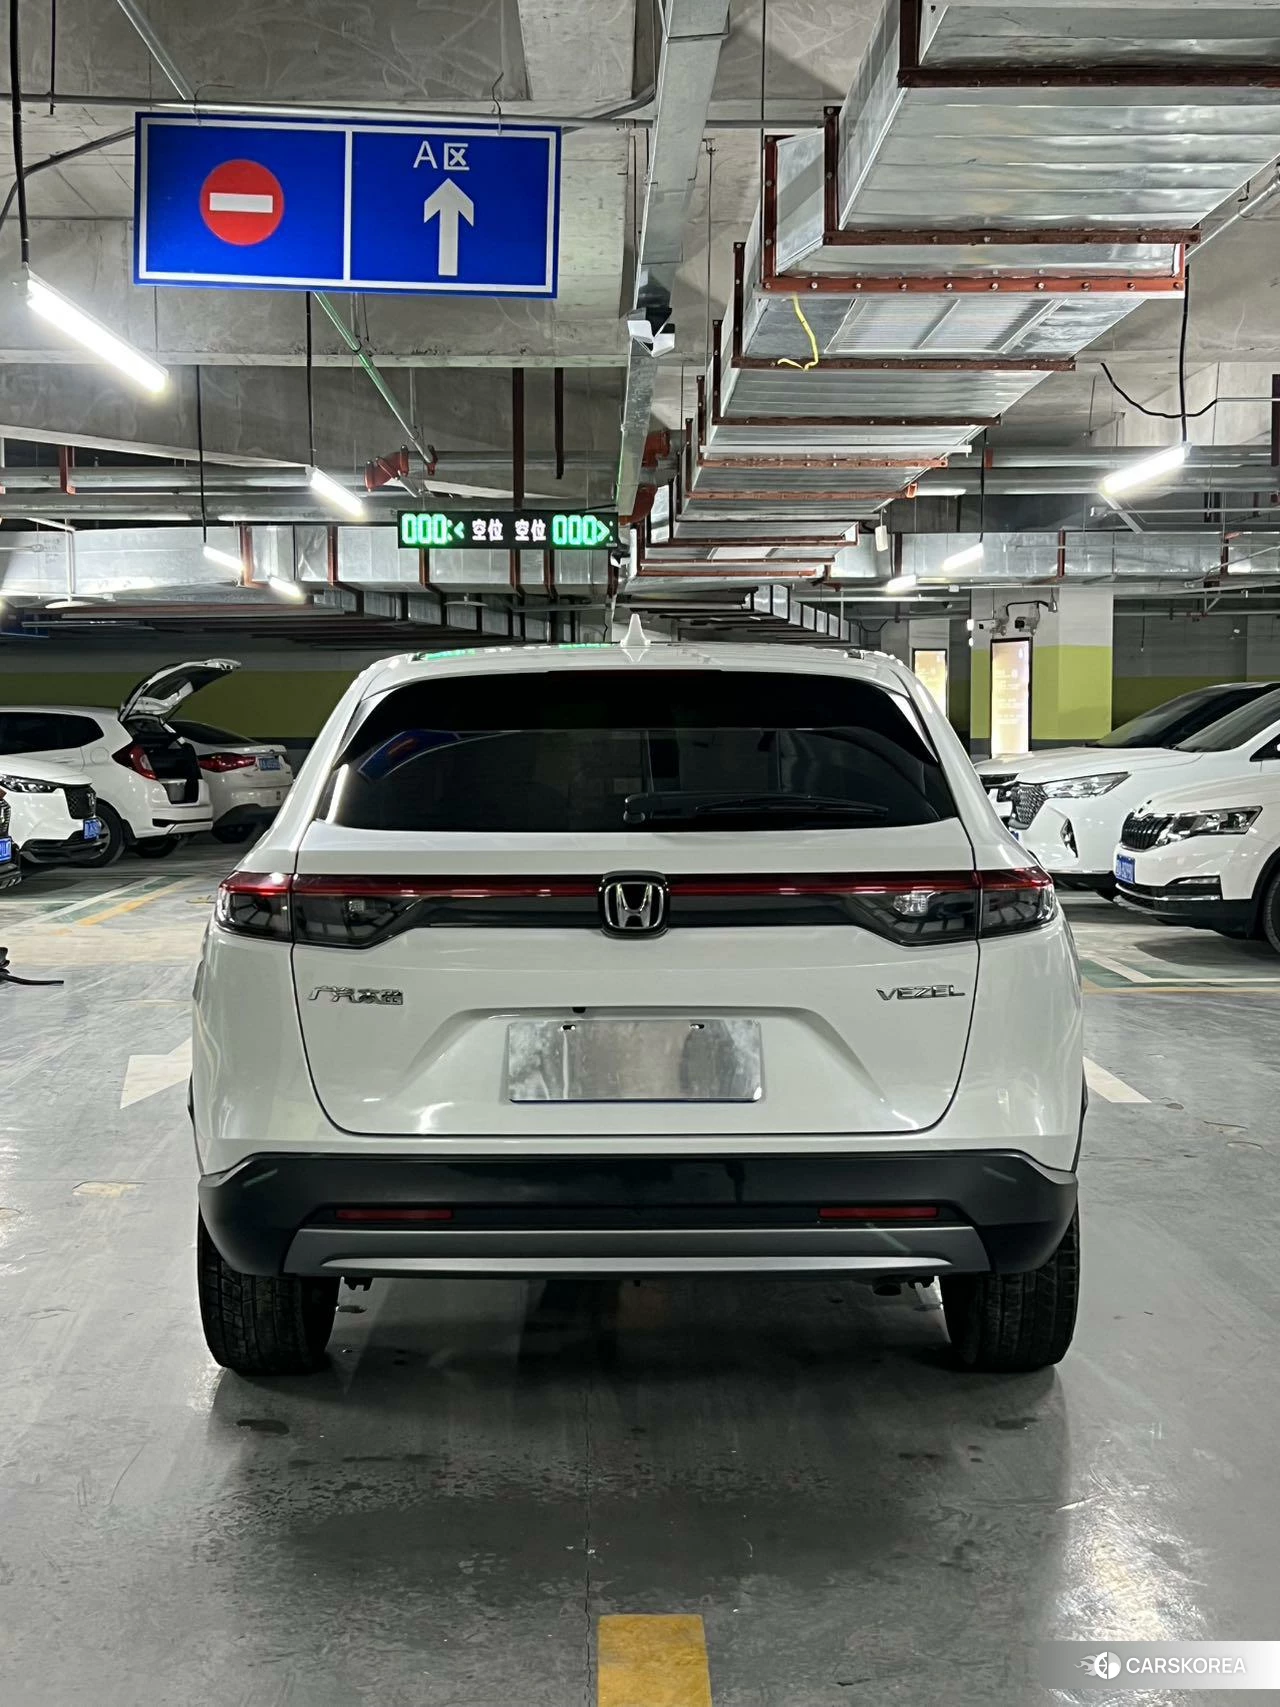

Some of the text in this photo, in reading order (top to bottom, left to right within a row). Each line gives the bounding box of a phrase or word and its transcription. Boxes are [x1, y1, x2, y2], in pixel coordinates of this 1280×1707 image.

[413, 140, 470, 171] A区
[472, 518, 504, 542] 空位
[515, 518, 547, 542] 空位
[876, 984, 966, 1001] VEZEL
